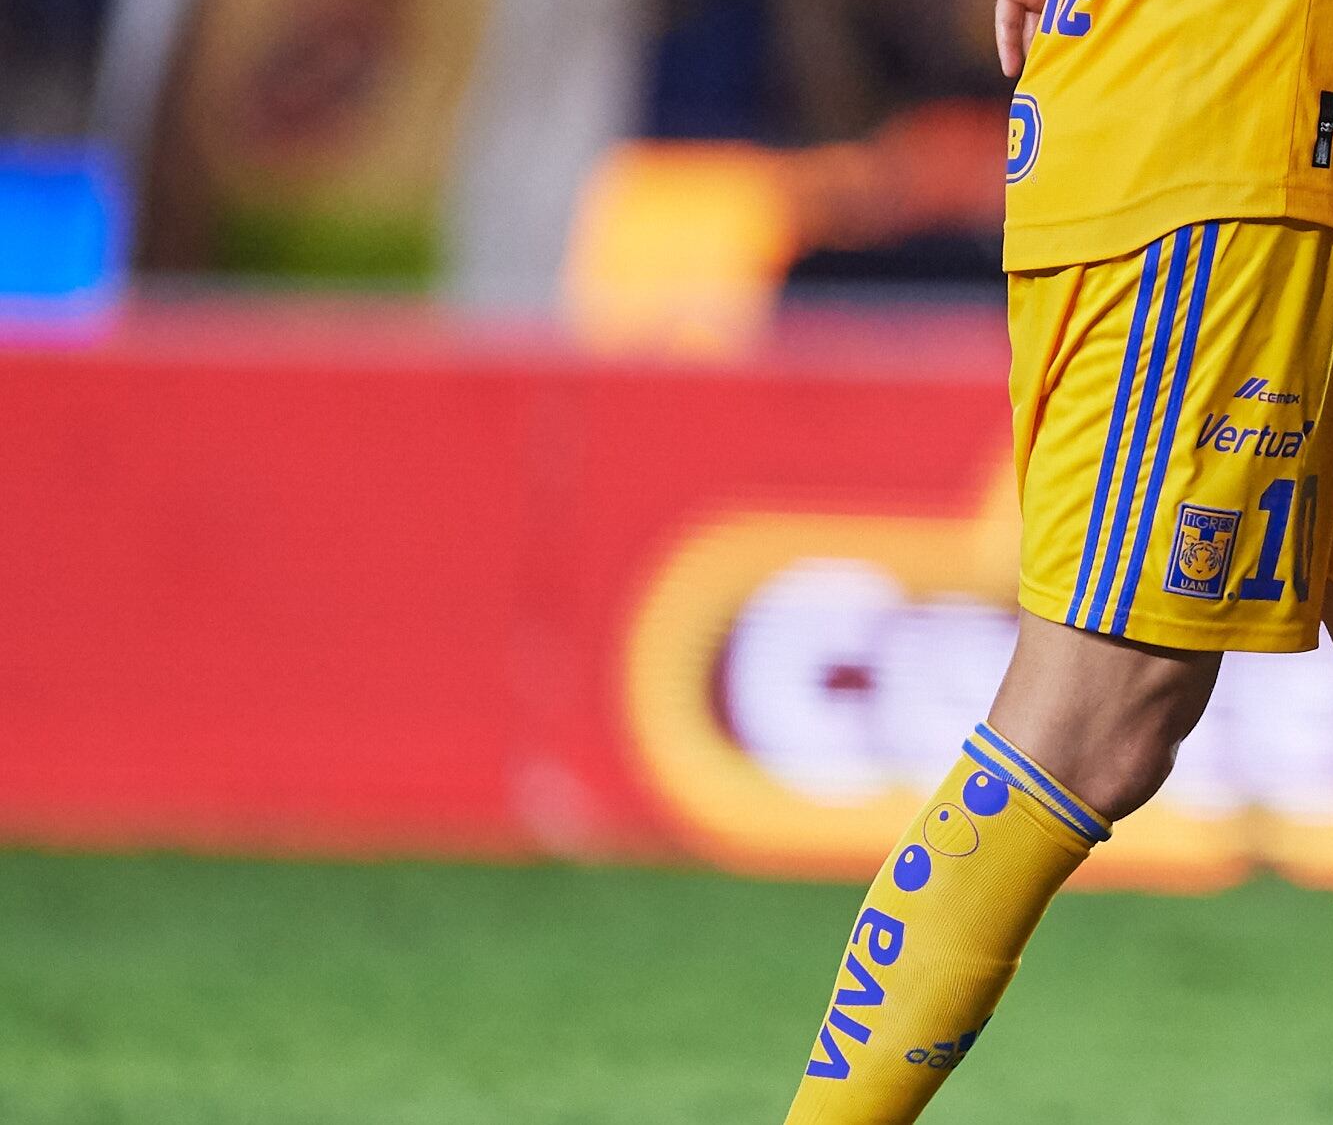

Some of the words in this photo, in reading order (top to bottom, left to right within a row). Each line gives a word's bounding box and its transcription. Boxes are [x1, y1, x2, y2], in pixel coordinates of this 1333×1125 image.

[1185, 512, 1234, 532] TIGRES
[1239, 475, 1319, 603] 10
[806, 907, 905, 1080] viva
